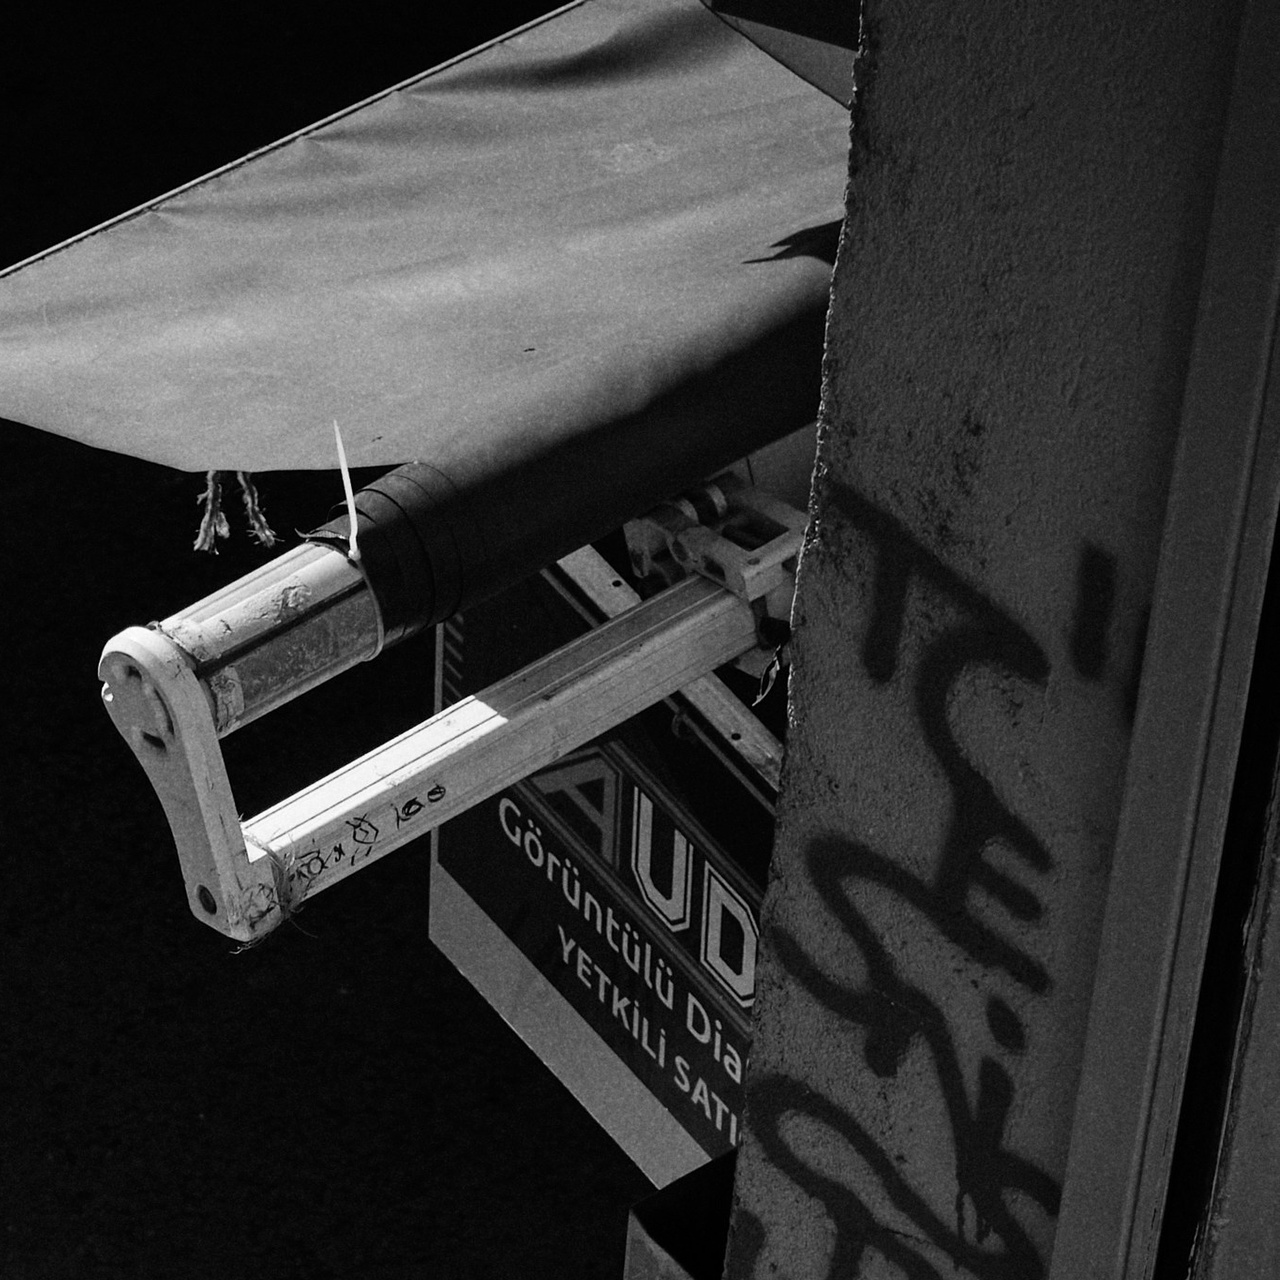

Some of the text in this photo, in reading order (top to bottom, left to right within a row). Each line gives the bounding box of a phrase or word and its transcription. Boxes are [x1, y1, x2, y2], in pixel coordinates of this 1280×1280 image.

[497, 796, 750, 1085] Görüntülü Dia
[556, 924, 742, 1147] YETKİLİ SATI
